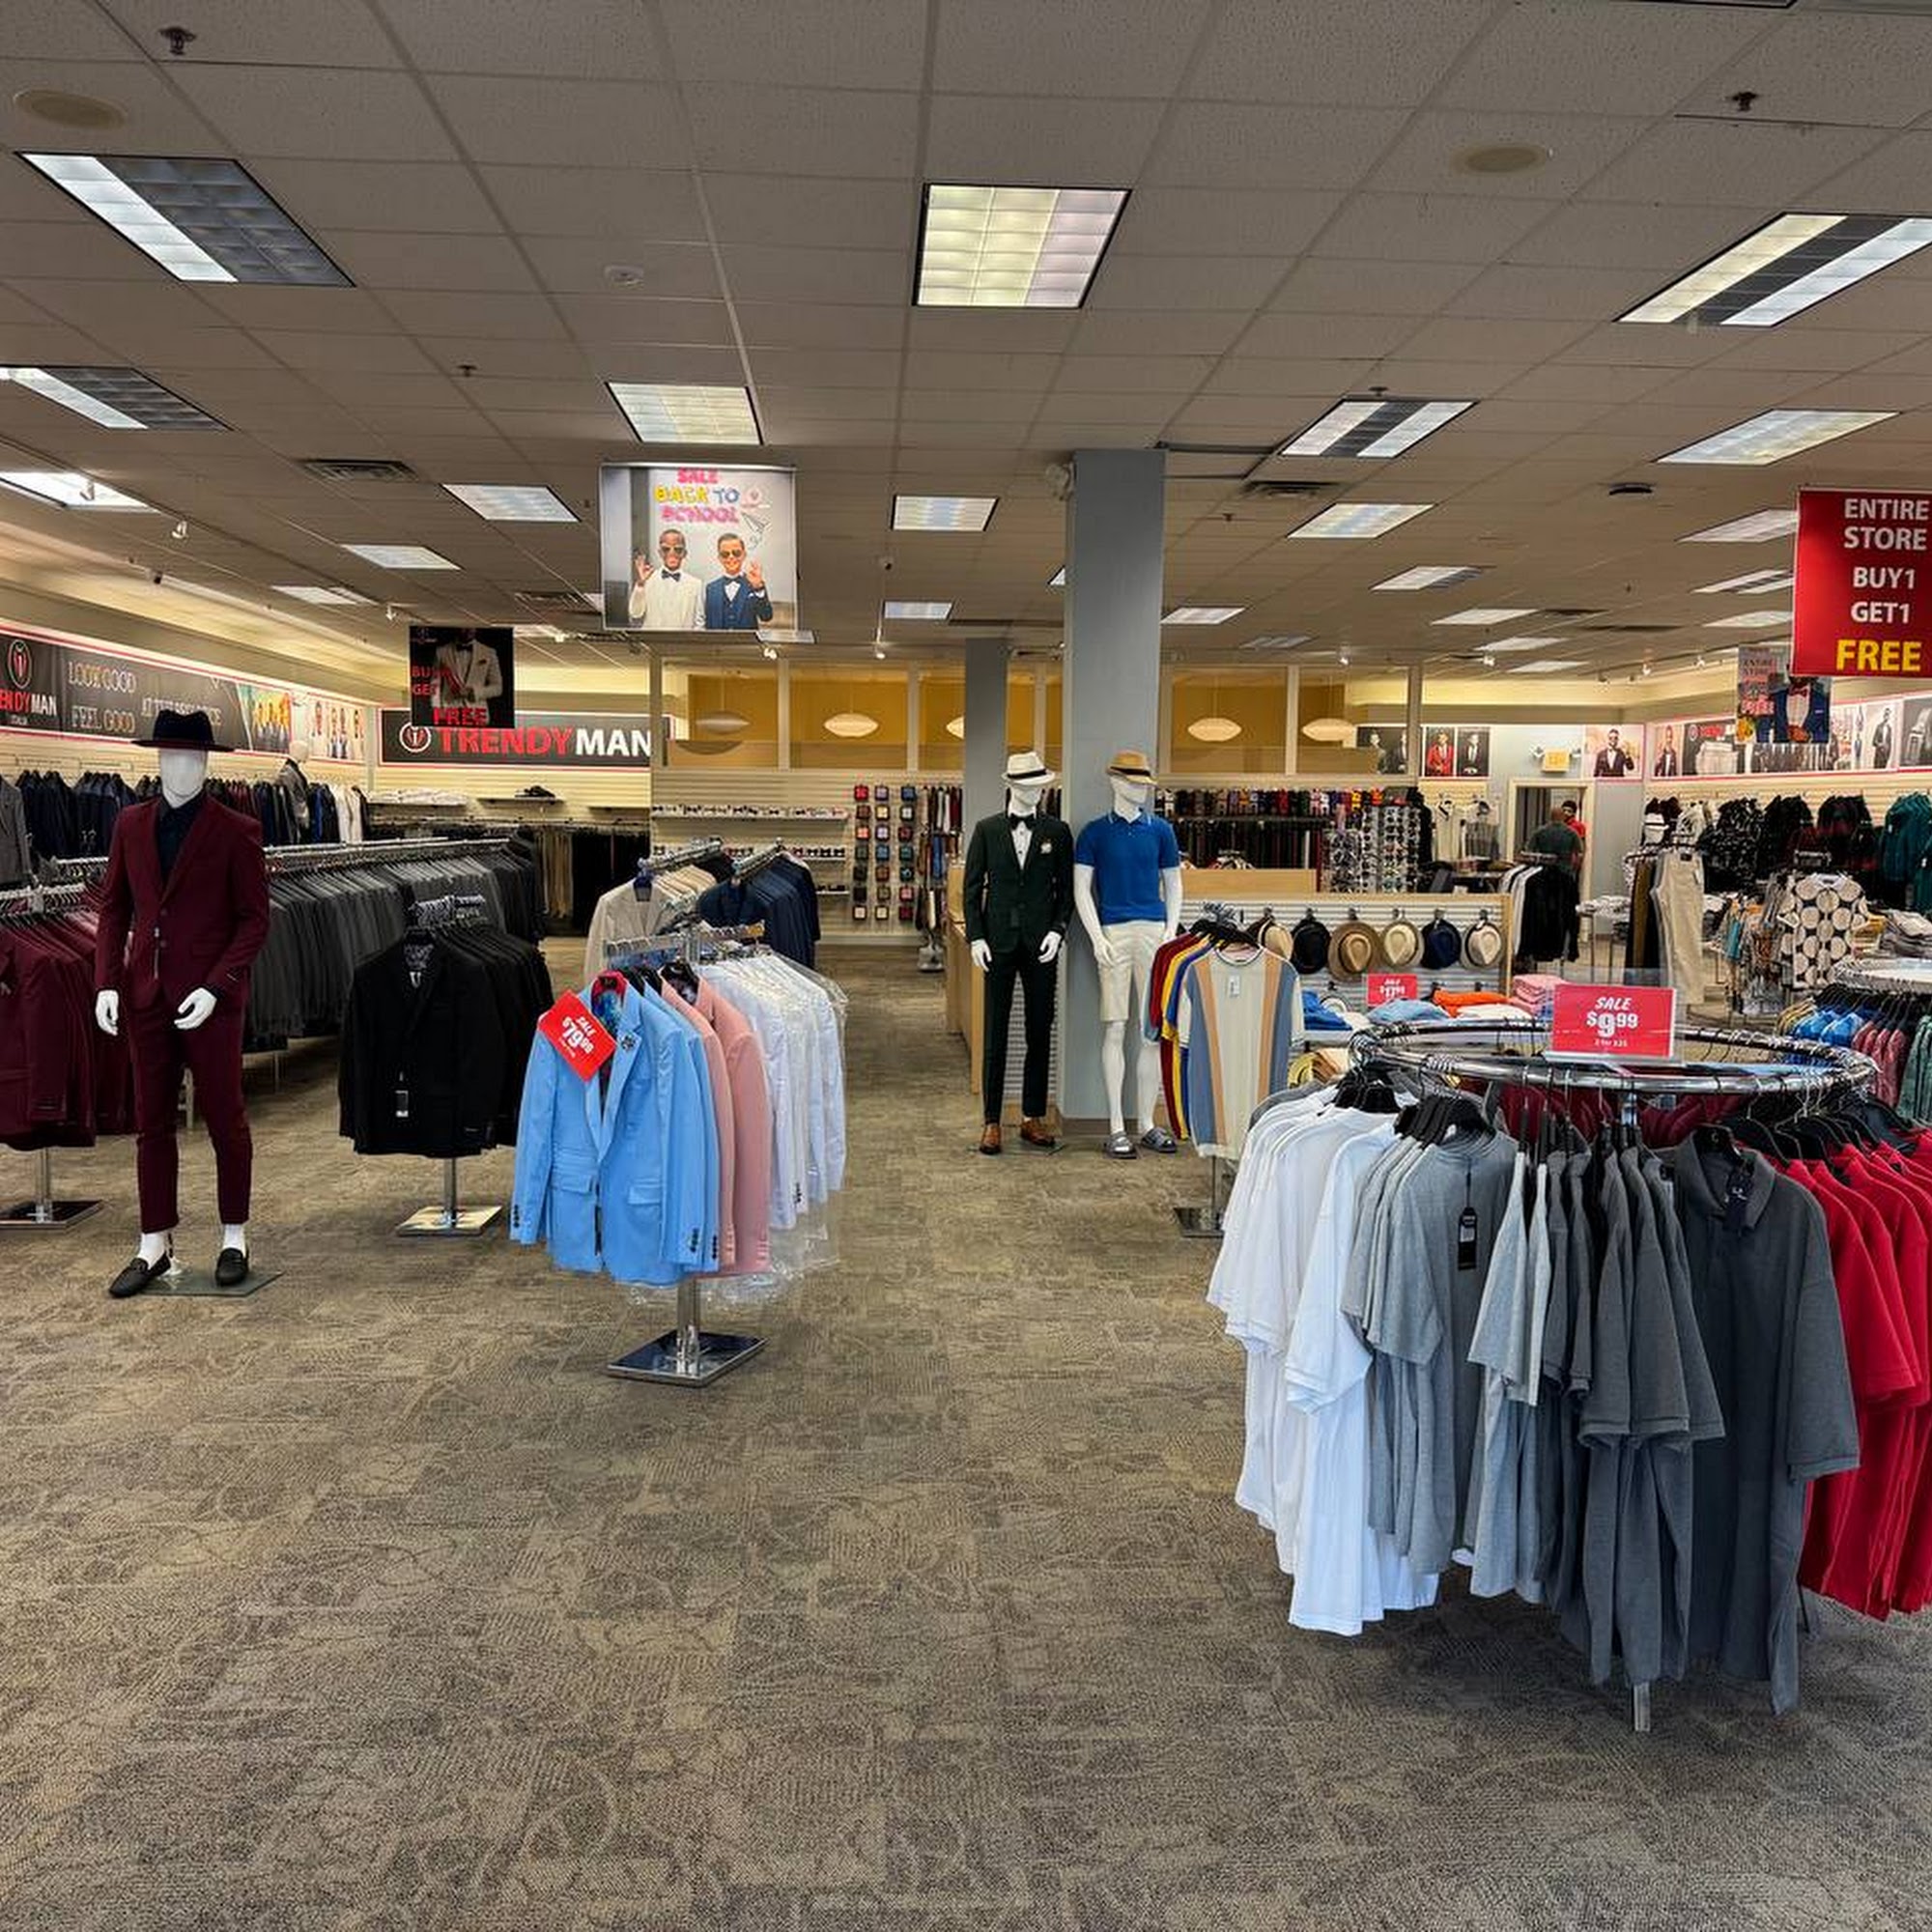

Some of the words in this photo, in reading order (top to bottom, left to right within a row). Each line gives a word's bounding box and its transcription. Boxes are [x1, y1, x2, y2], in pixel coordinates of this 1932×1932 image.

[677, 468, 720, 483] SALE
[654, 486, 709, 502] BACK
[713, 487, 741, 503] TO
[661, 505, 740, 523] SCHOOL
[1844, 498, 1930, 521] ENTIRE
[1843, 526, 1927, 551] STORE
[1836, 639, 1922, 671] FREE
[71, 704, 102, 729] FEEL
[1594, 997, 1633, 1010] SALE
